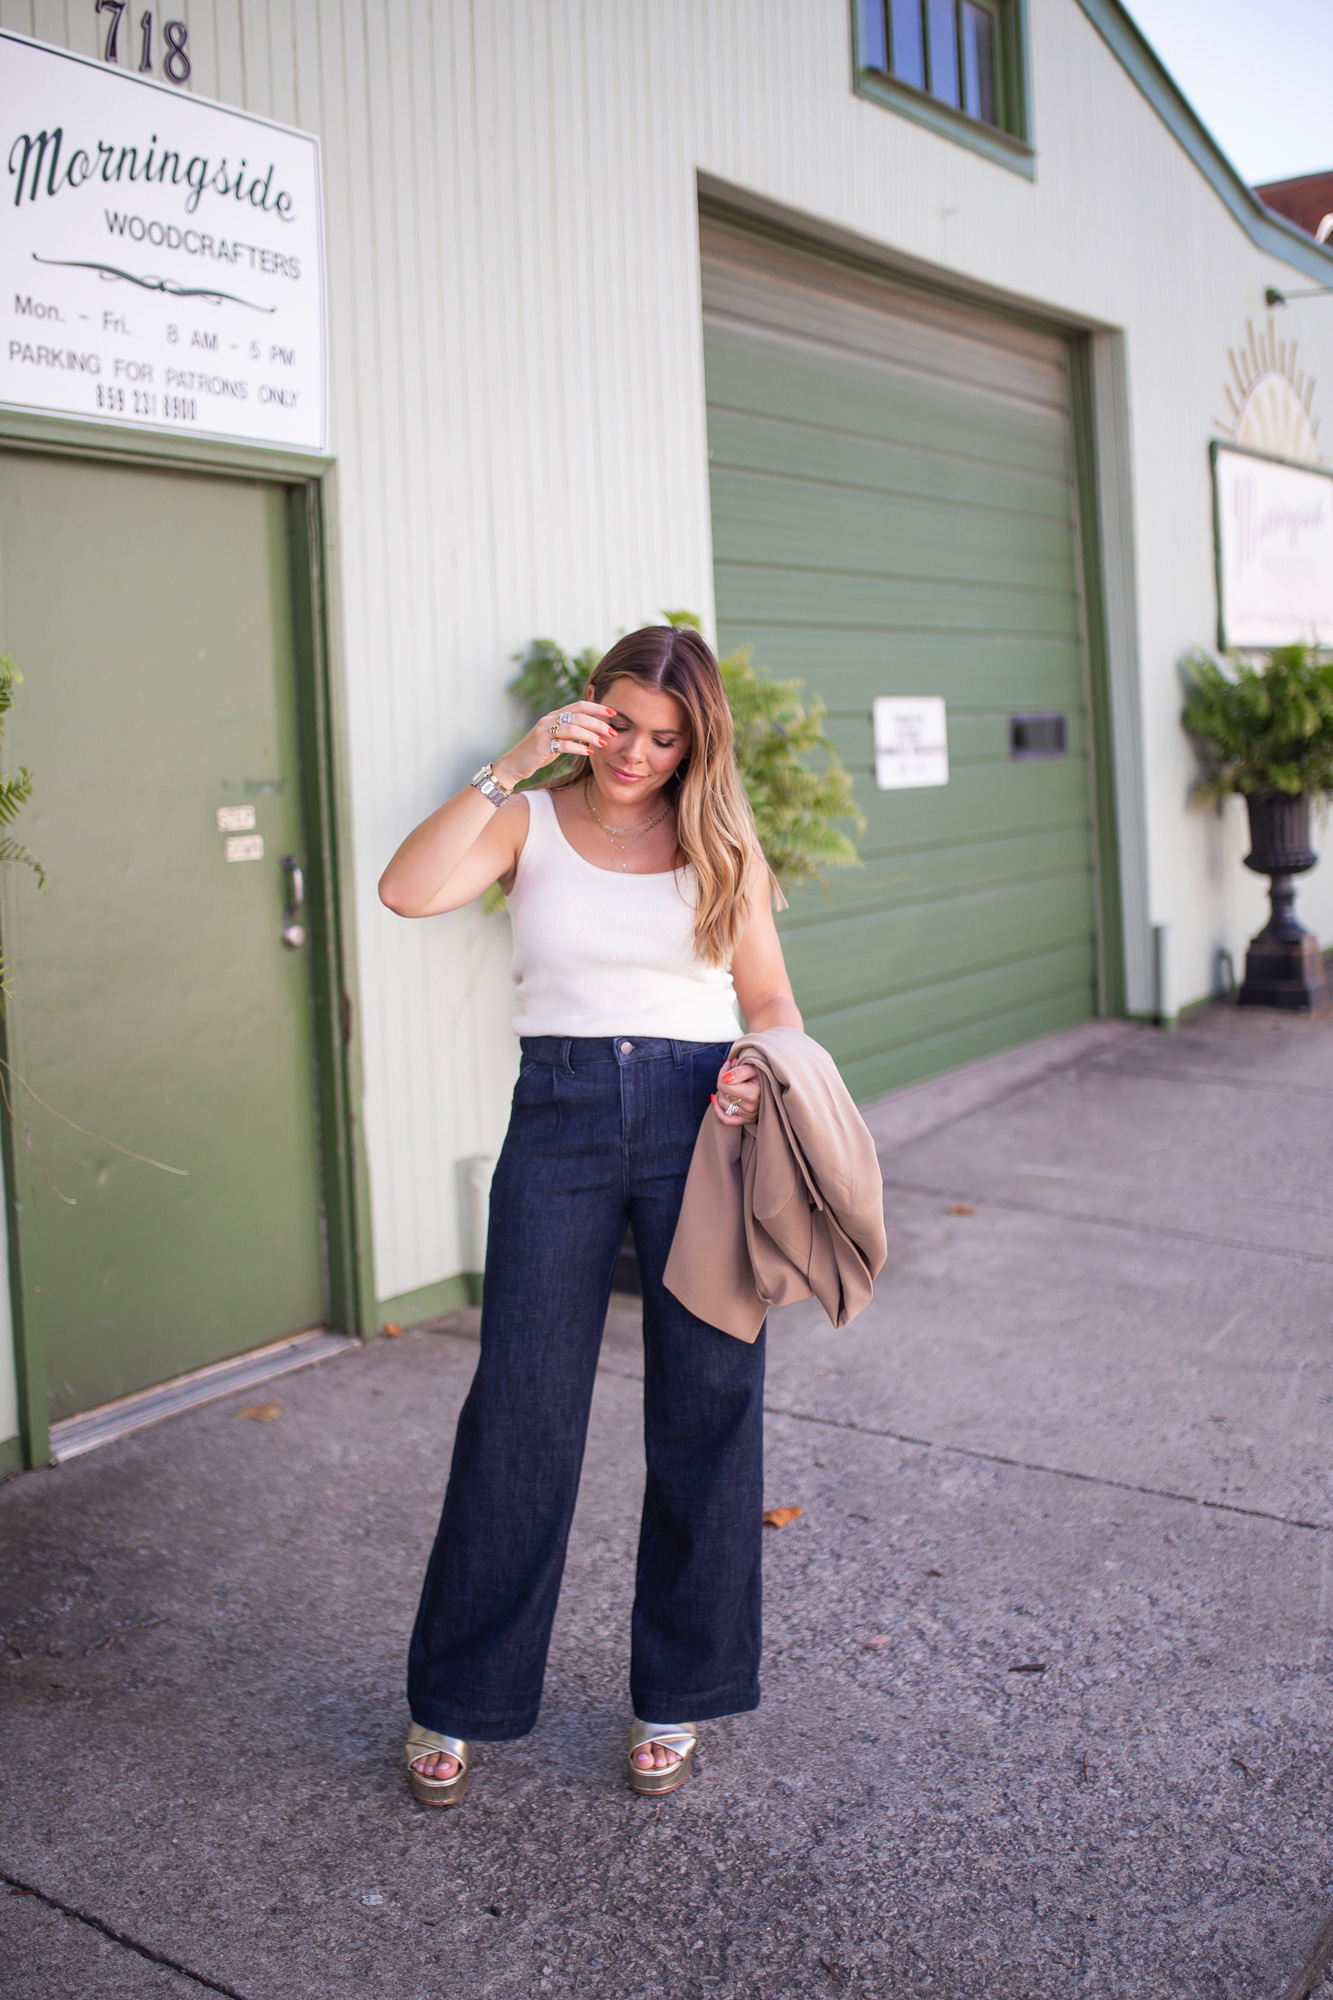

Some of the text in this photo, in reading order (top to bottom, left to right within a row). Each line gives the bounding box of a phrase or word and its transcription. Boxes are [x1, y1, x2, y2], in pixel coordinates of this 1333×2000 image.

[96, 0, 191, 83] 718
[8, 127, 296, 221] Morningside
[104, 209, 301, 280] WOODCRAFTERS
[14, 293, 65, 323] Mon.
[102, 310, 132, 336] Fri.
[166, 323, 179, 344] 8
[190, 329, 218, 351] AM
[248, 340, 261, 359] 5
[270, 344, 295, 366] PM
[9, 340, 299, 408] PARKING FOR PATRONS ONLY
